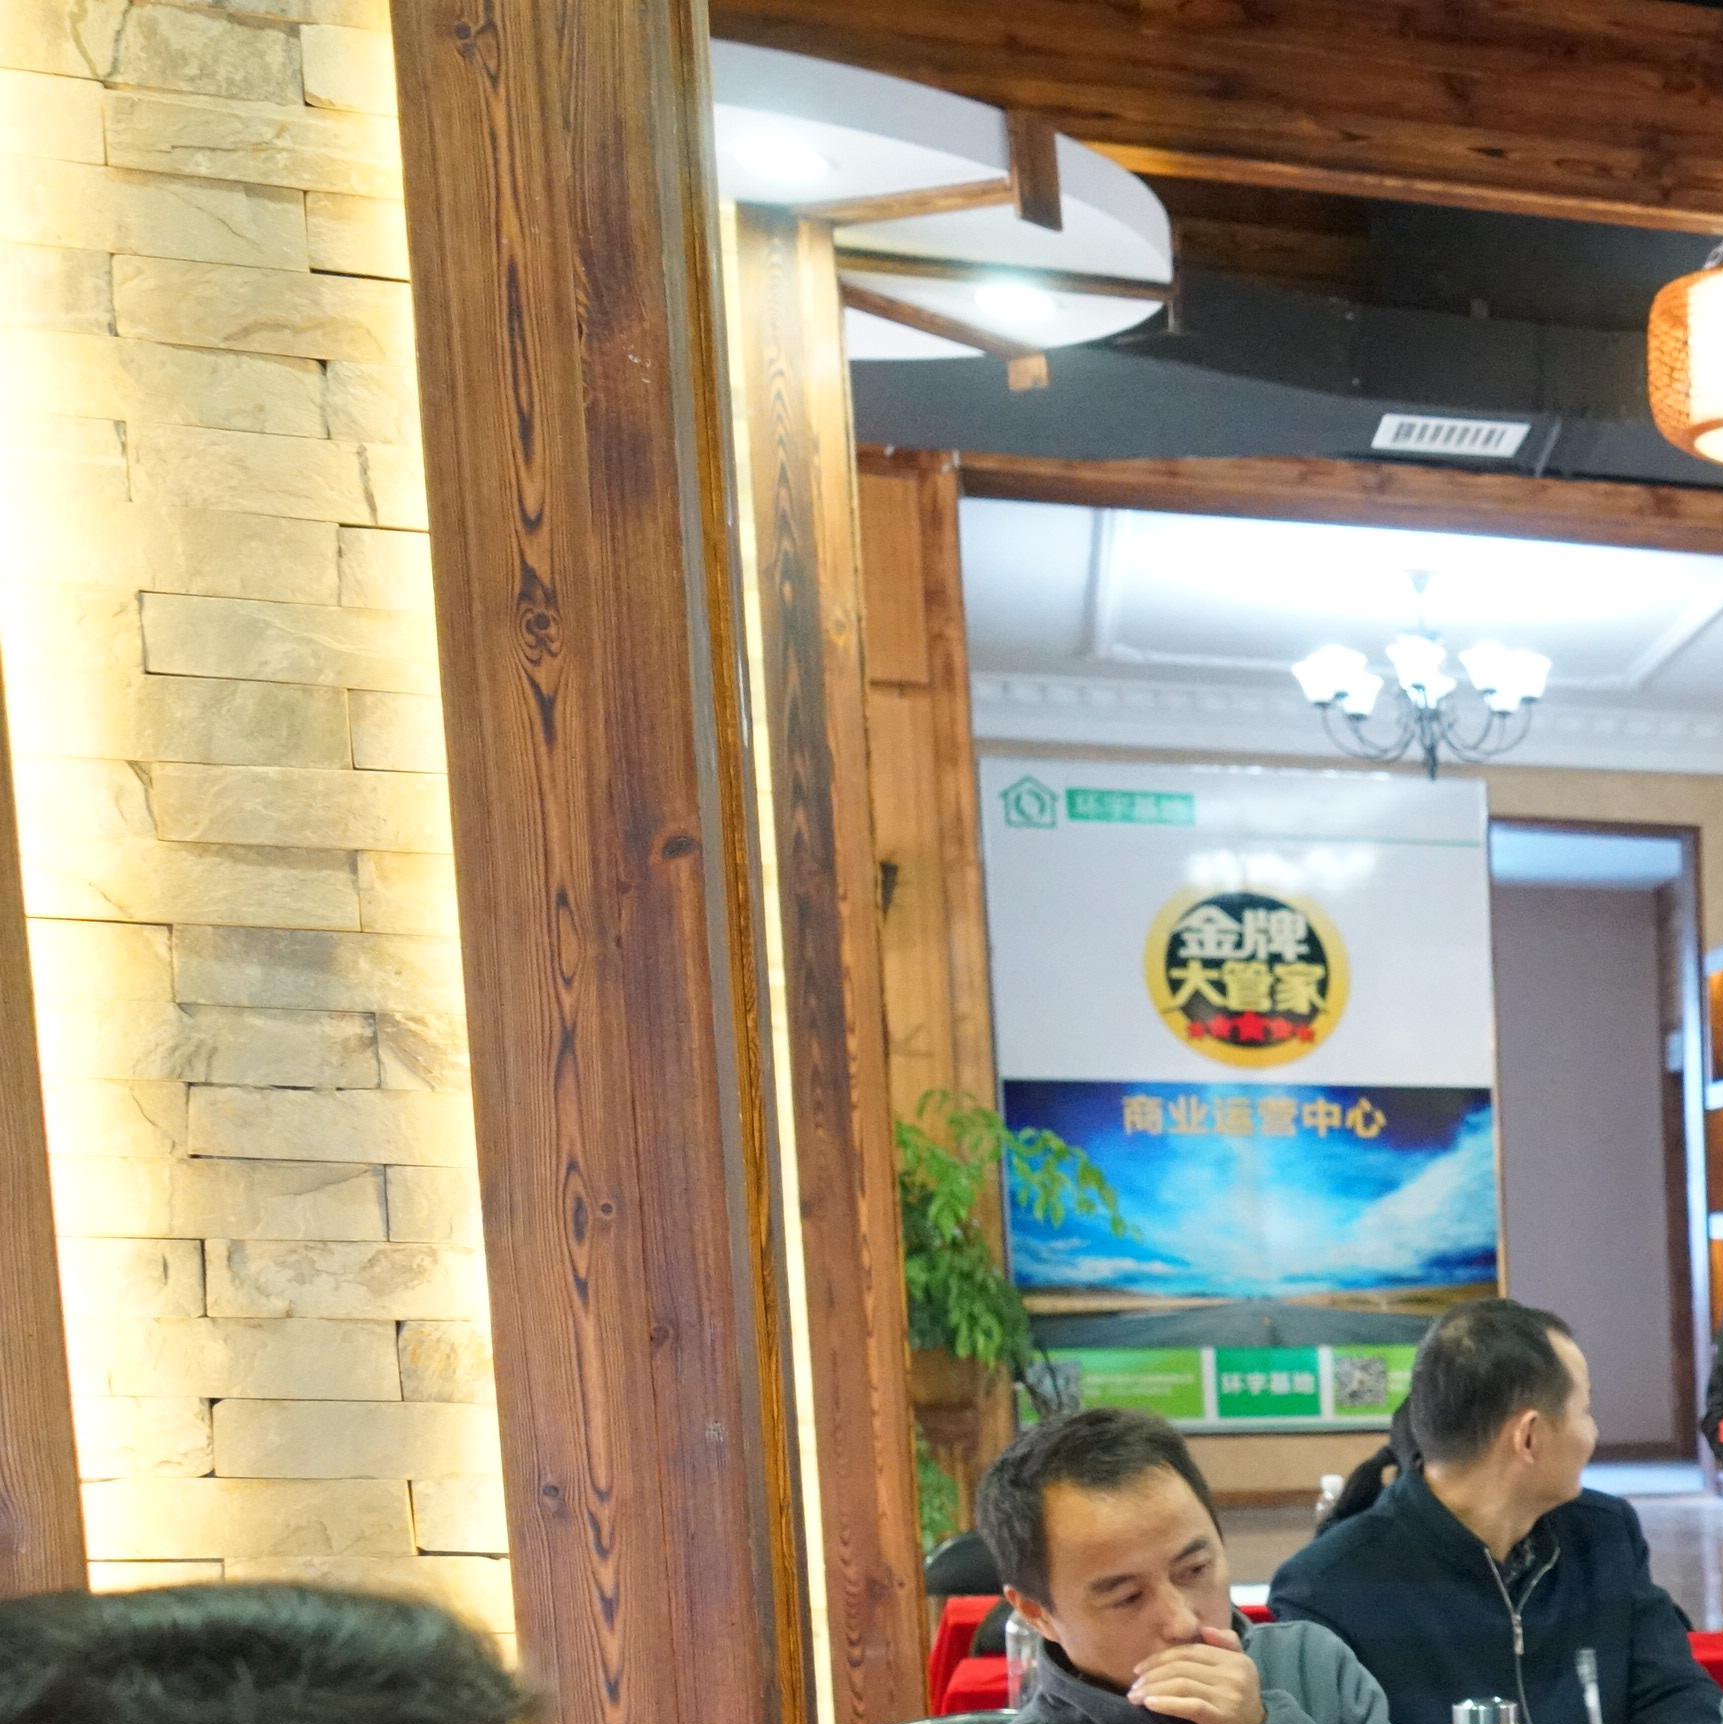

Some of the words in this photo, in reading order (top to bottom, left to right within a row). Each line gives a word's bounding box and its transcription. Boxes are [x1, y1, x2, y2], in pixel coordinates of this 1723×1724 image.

[1172, 904, 1310, 961] 金牌
[1165, 958, 1328, 1015] 大管家
[1122, 1094, 1387, 1138] 商业运营中心
